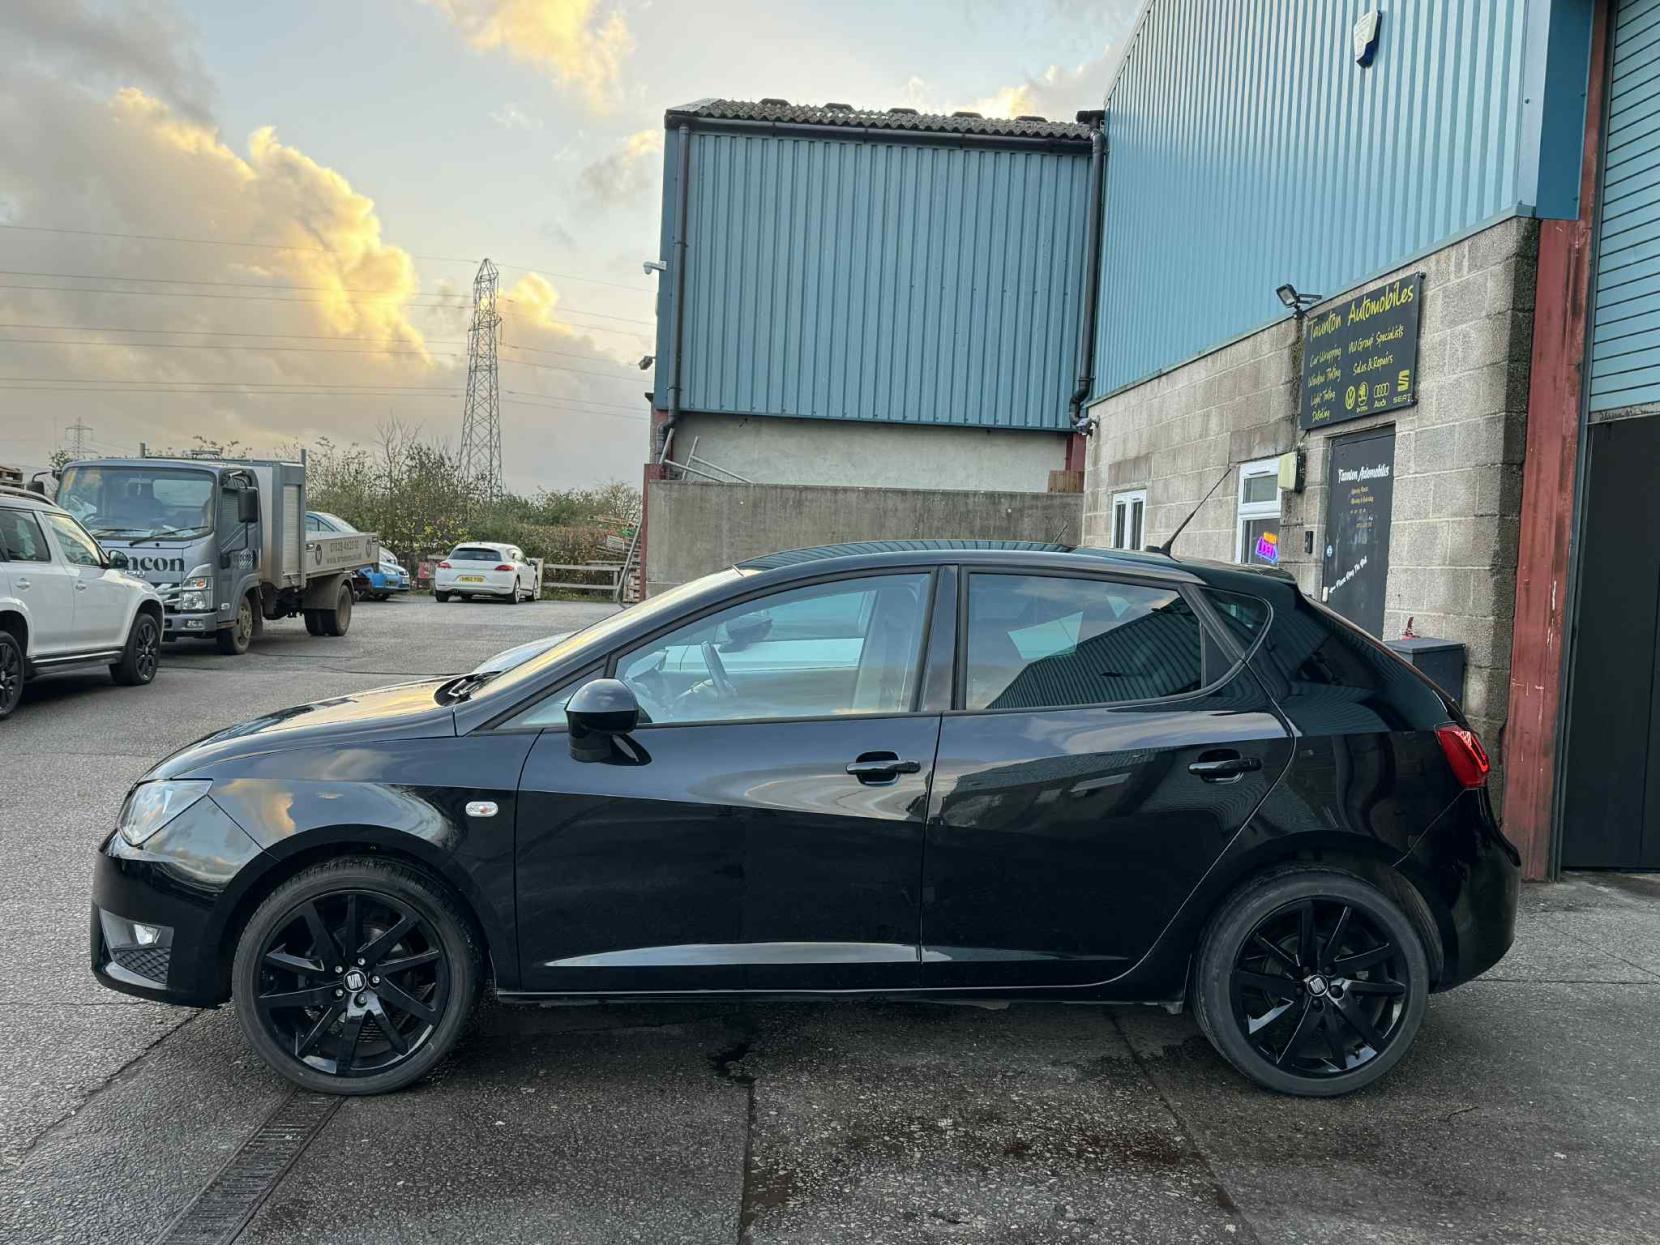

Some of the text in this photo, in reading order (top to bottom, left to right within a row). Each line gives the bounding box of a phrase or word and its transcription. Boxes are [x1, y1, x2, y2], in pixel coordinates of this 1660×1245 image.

[1308, 281, 1414, 342] Taunton Automobiles
[1376, 324, 1404, 347] Specialists
[1373, 398, 1387, 408] Audi
[1392, 393, 1413, 404] SEAT
